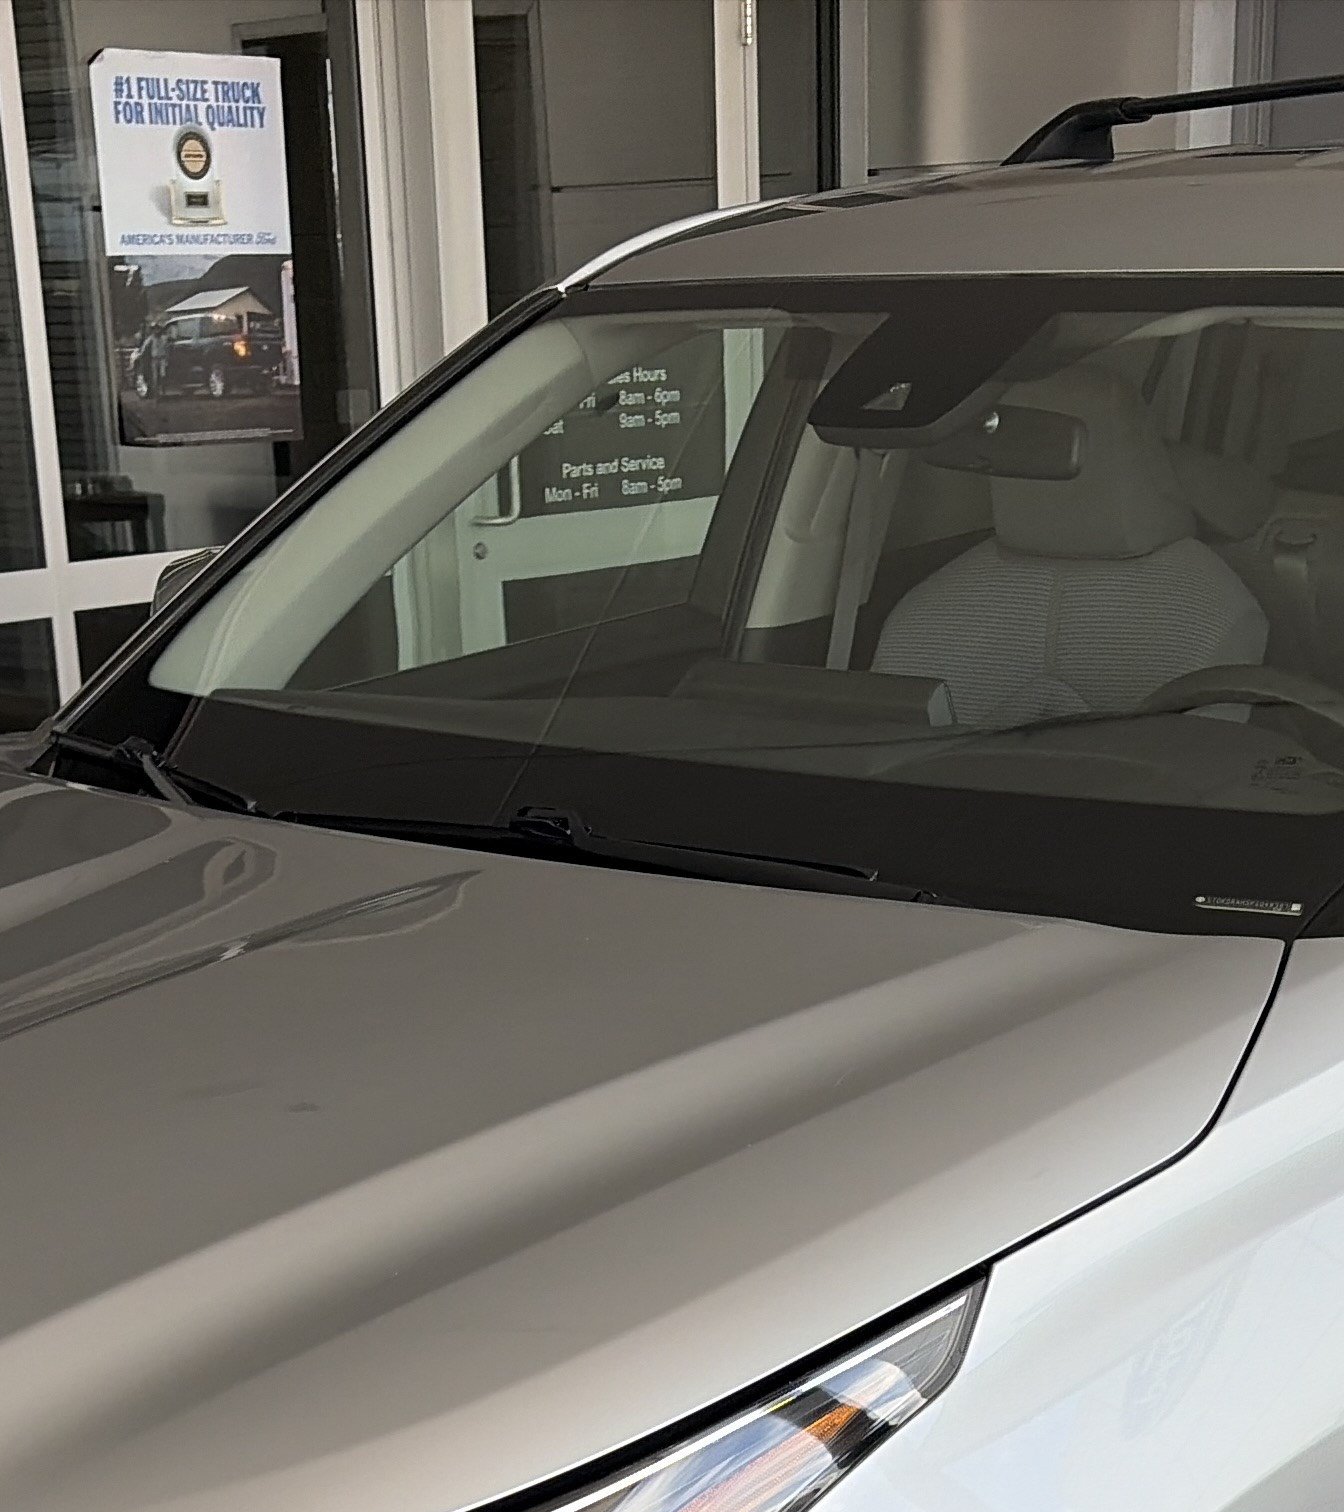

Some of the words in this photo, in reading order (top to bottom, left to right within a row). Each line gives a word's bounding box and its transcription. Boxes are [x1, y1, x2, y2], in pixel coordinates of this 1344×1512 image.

[113, 75, 133, 99] #1
[136, 76, 210, 102] FULL-SIZE
[212, 80, 262, 105] TRUCK
[113, 101, 144, 124] FOR
[148, 102, 203, 126] INITIAL
[206, 105, 266, 131] QUALITY
[120, 233, 174, 245] AMERICA'S
[175, 233, 253, 245] MANUFACTURER
[632, 366, 667, 382] Hours
[618, 389, 645, 405] 8am
[654, 387, 681, 406] 6pm
[618, 412, 645, 428] 9am
[654, 410, 681, 428] 5pm
[562, 462, 594, 478] Parts
[595, 458, 619, 474] and
[620, 454, 666, 472] Service
[544, 487, 572, 503] Mon
[582, 483, 599, 499] Fri
[621, 479, 648, 495] 8am
[657, 476, 682, 494] 5pm
